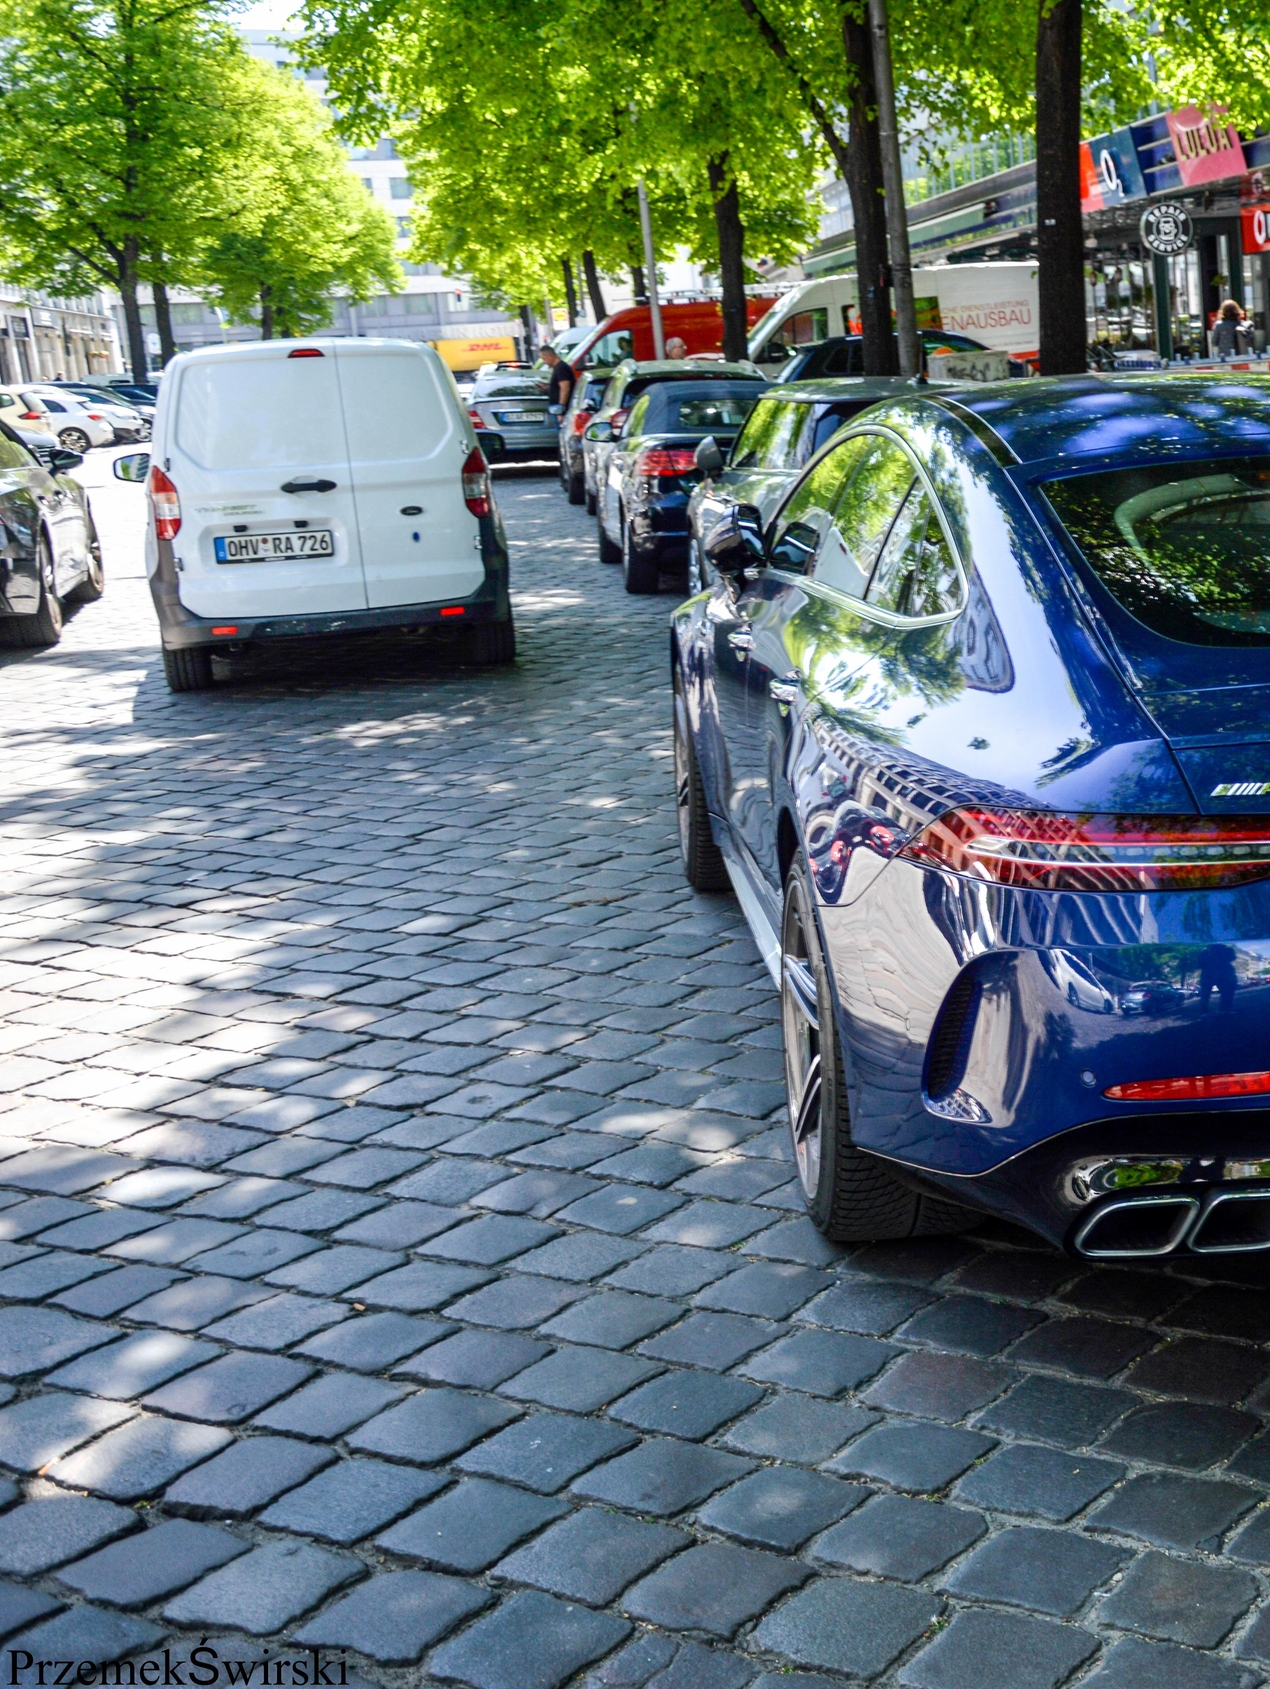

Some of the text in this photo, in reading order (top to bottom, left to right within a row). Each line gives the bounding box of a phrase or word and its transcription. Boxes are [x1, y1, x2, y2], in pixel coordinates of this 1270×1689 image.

[1176, 124, 1233, 161] LULUA
[1147, 205, 1187, 223] REPAIR
[1147, 234, 1189, 252] SERVICE
[961, 299, 1029, 313] DIENSTLEISTUNG
[227, 539, 259, 557] OHV
[272, 537, 294, 554] RA
[298, 534, 329, 552] 726
